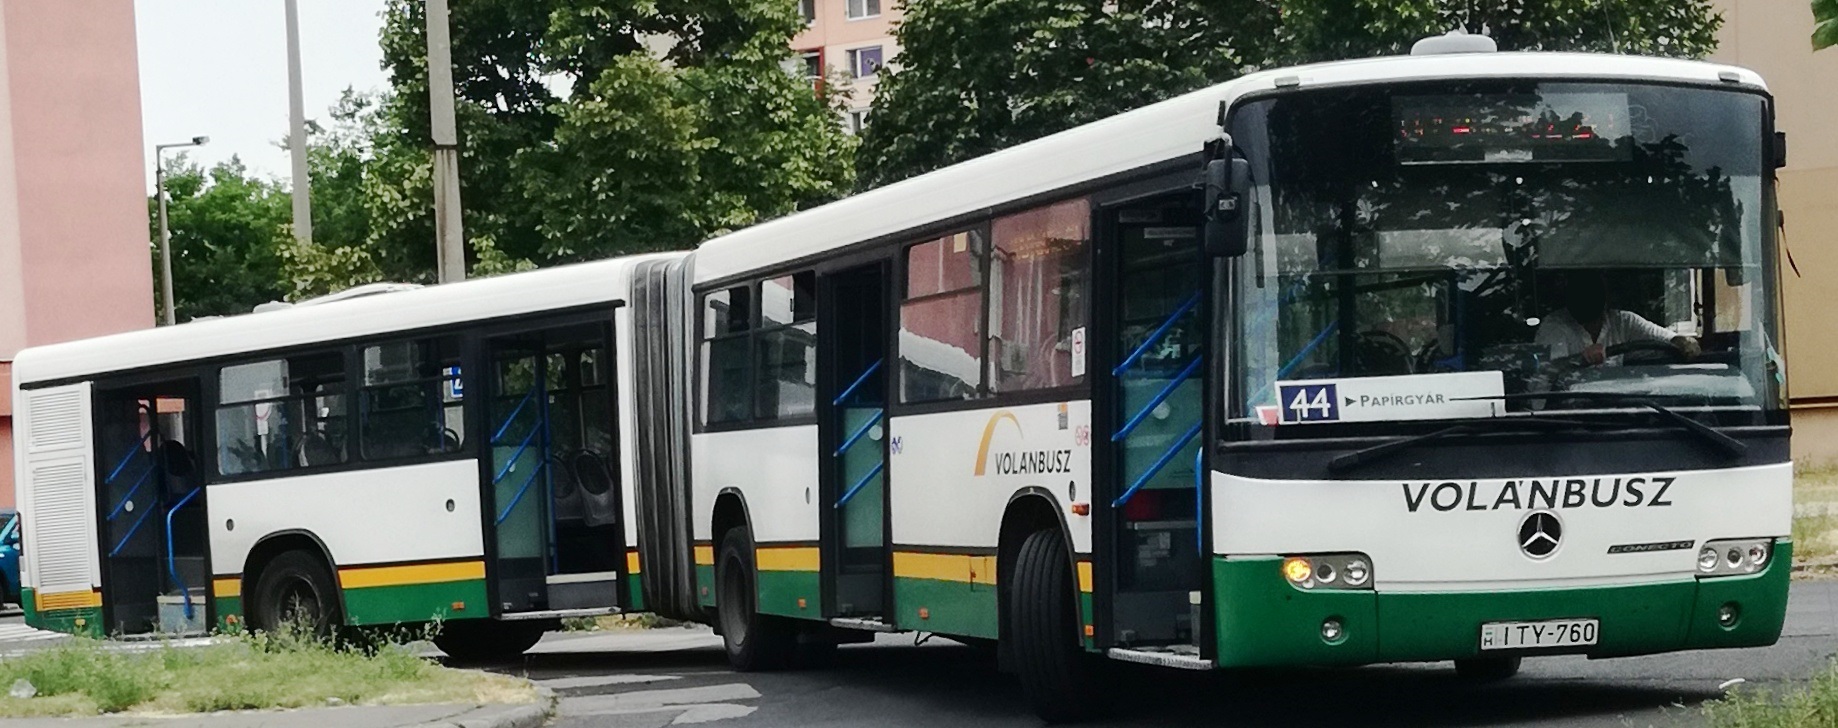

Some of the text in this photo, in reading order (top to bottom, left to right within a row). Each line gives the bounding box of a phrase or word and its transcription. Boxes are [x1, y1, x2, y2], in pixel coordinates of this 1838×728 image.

[1289, 387, 1332, 419] 44
[1402, 476, 1677, 513] VOLÁNBUSZ
[1503, 622, 1596, 647] ITY-760
